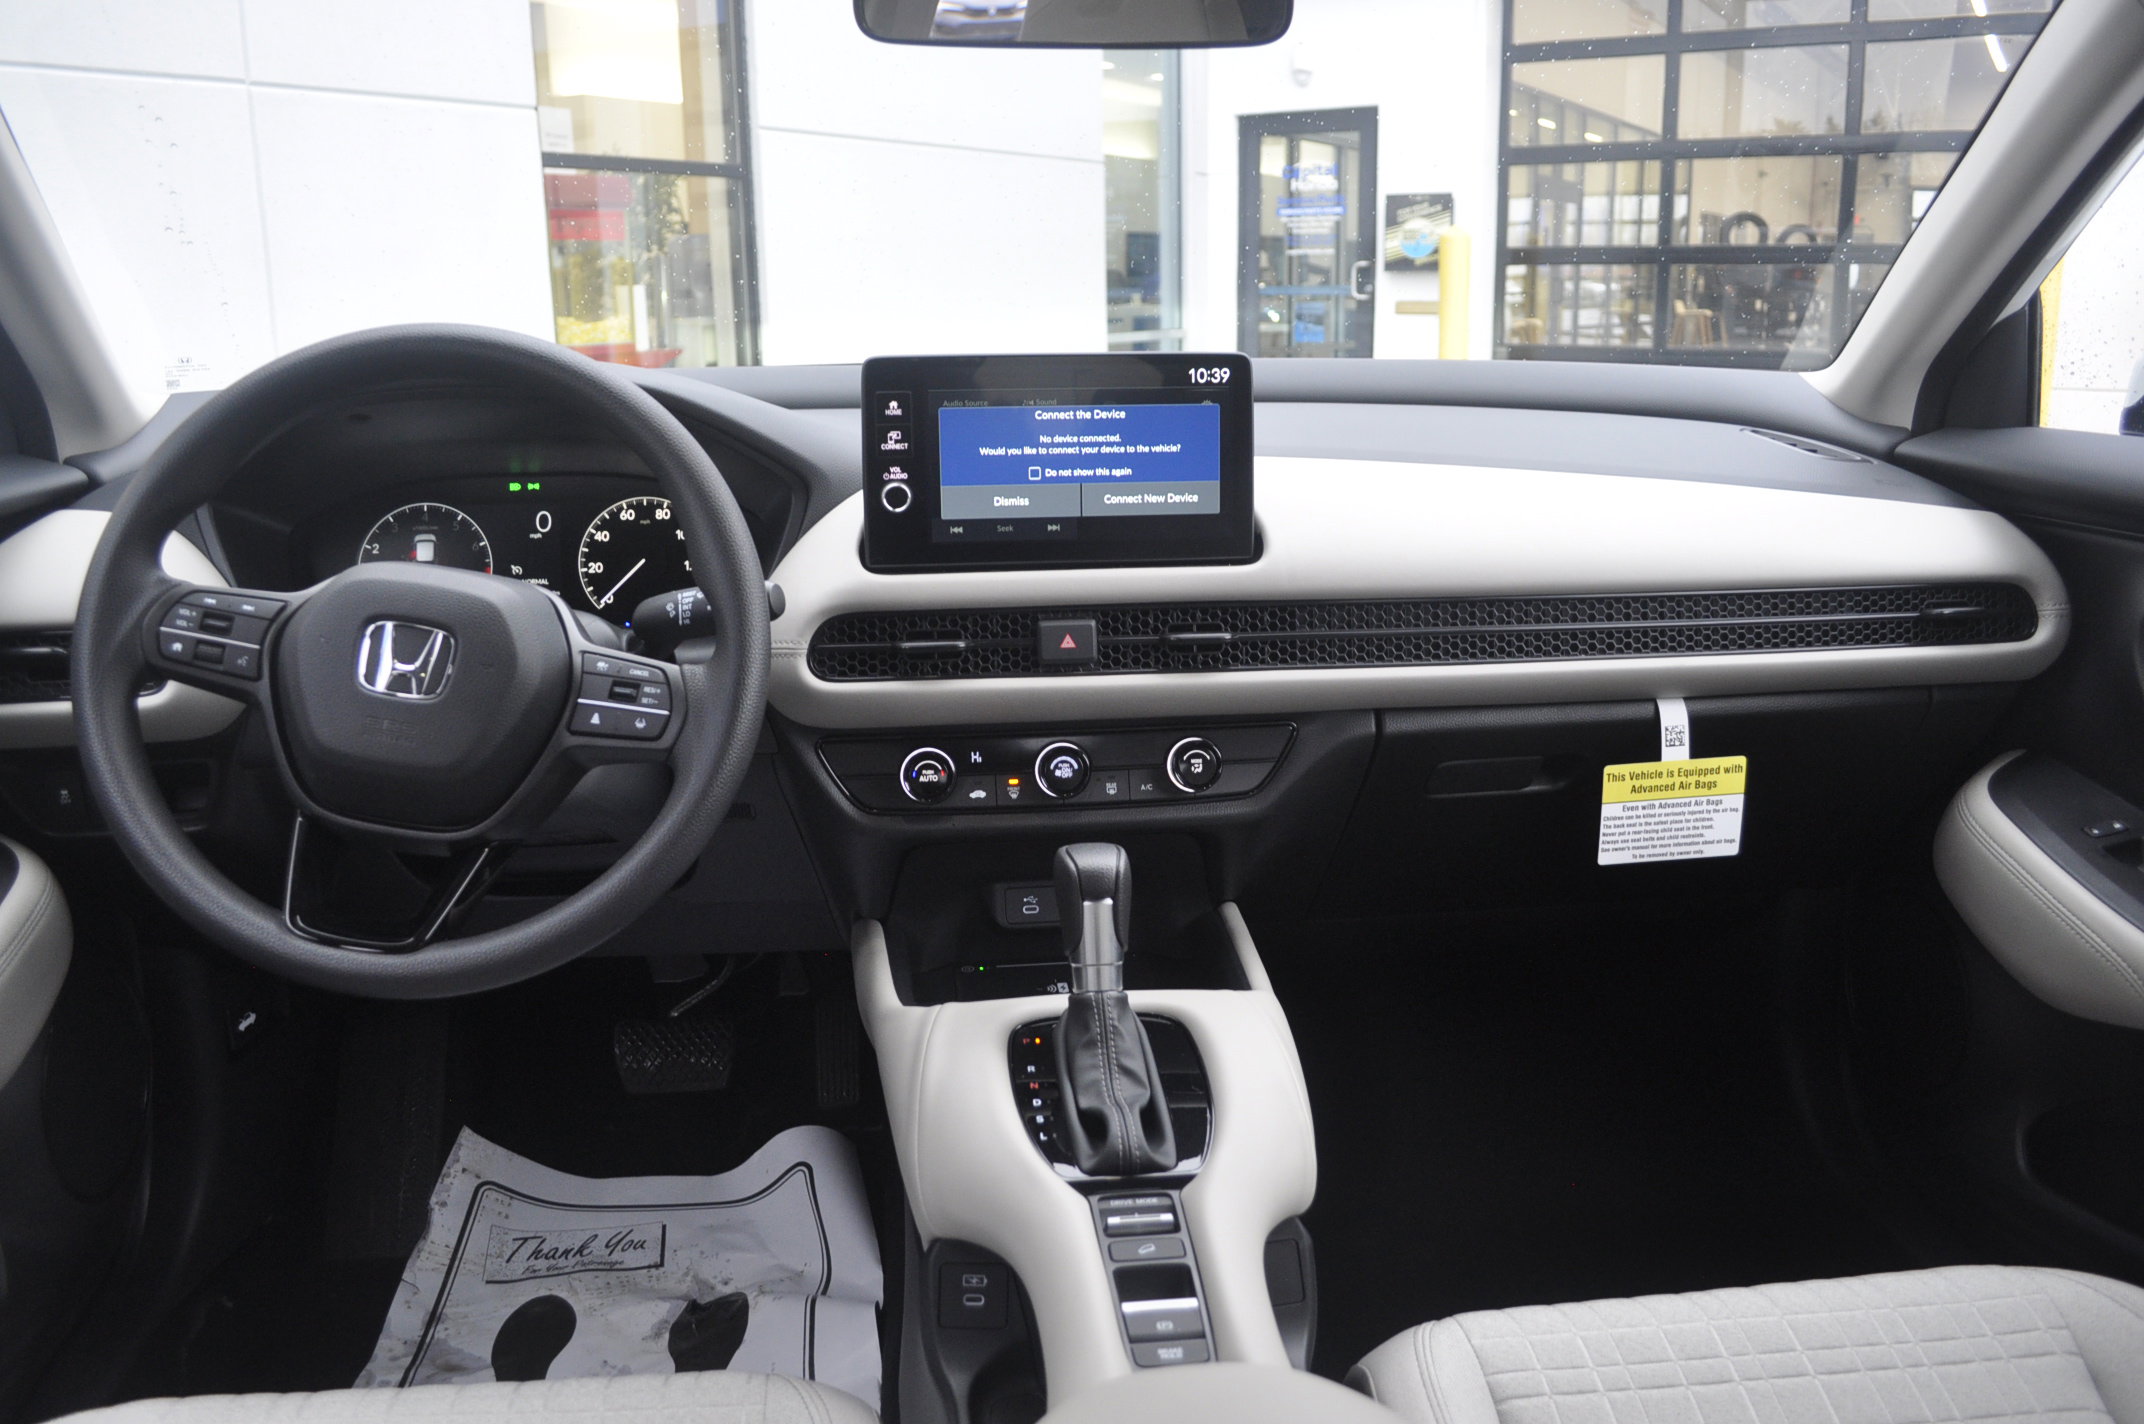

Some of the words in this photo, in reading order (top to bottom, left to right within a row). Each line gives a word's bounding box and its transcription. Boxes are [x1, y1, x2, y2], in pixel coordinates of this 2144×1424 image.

[1188, 367, 1230, 383] 10:39
[1034, 410, 1074, 420] Connect
[1076, 410, 1092, 420] the
[1094, 408, 1126, 420] Device
[1040, 434, 1052, 444] No
[1053, 434, 1079, 444] device
[1080, 433, 1122, 442] connected.
[979, 446, 1006, 456] Would
[1007, 447, 1022, 457] you
[1023, 446, 1037, 455] like
[1038, 446, 1048, 454] to
[1048, 446, 1080, 454] connect
[1081, 446, 1099, 456] your
[1100, 444, 1126, 454] device
[1126, 444, 1136, 454] to
[1136, 444, 1150, 453] the
[1151, 443, 1182, 453] vehicle?
[1045, 468, 1058, 477] Do
[1058, 468, 1072, 476] not
[1073, 467, 1094, 477] show
[1095, 467, 1110, 476] this
[1111, 467, 1132, 477] again
[993, 496, 1030, 507] Dismiss
[1104, 493, 1142, 504] Connect
[1144, 493, 1166, 504] New
[1167, 492, 1199, 503] Device
[620, 509, 636, 521] 60
[655, 508, 671, 520] 80
[536, 510, 552, 533] 0
[997, 524, 1014, 532] Seek
[594, 530, 610, 542] 40
[372, 543, 380, 554] 2
[588, 562, 604, 574] 20
[682, 610, 691, 618] LO
[919, 774, 938, 782] AUTO
[1606, 772, 1626, 783] This
[1628, 769, 1664, 781] Vehicle
[1666, 768, 1675, 778] is
[1677, 765, 1721, 778] Equipped
[1723, 763, 1744, 774] with
[1140, 783, 1153, 791] A/C
[1630, 782, 1676, 794] Advanced
[1678, 780, 1692, 791] Air
[1695, 779, 1718, 791] Bags
[1622, 804, 1640, 812] Even
[1641, 803, 1656, 811] with
[1657, 800, 1692, 810] Advanced
[1694, 799, 1704, 807] Air
[1706, 798, 1723, 807] Bags
[1027, 1064, 1036, 1072] R
[1029, 1081, 1039, 1090] N
[1032, 1098, 1042, 1107] D
[1039, 1131, 1048, 1140] L
[505, 1234, 598, 1264] Thank
[604, 1229, 647, 1257] You
[521, 1264, 541, 1275] For
